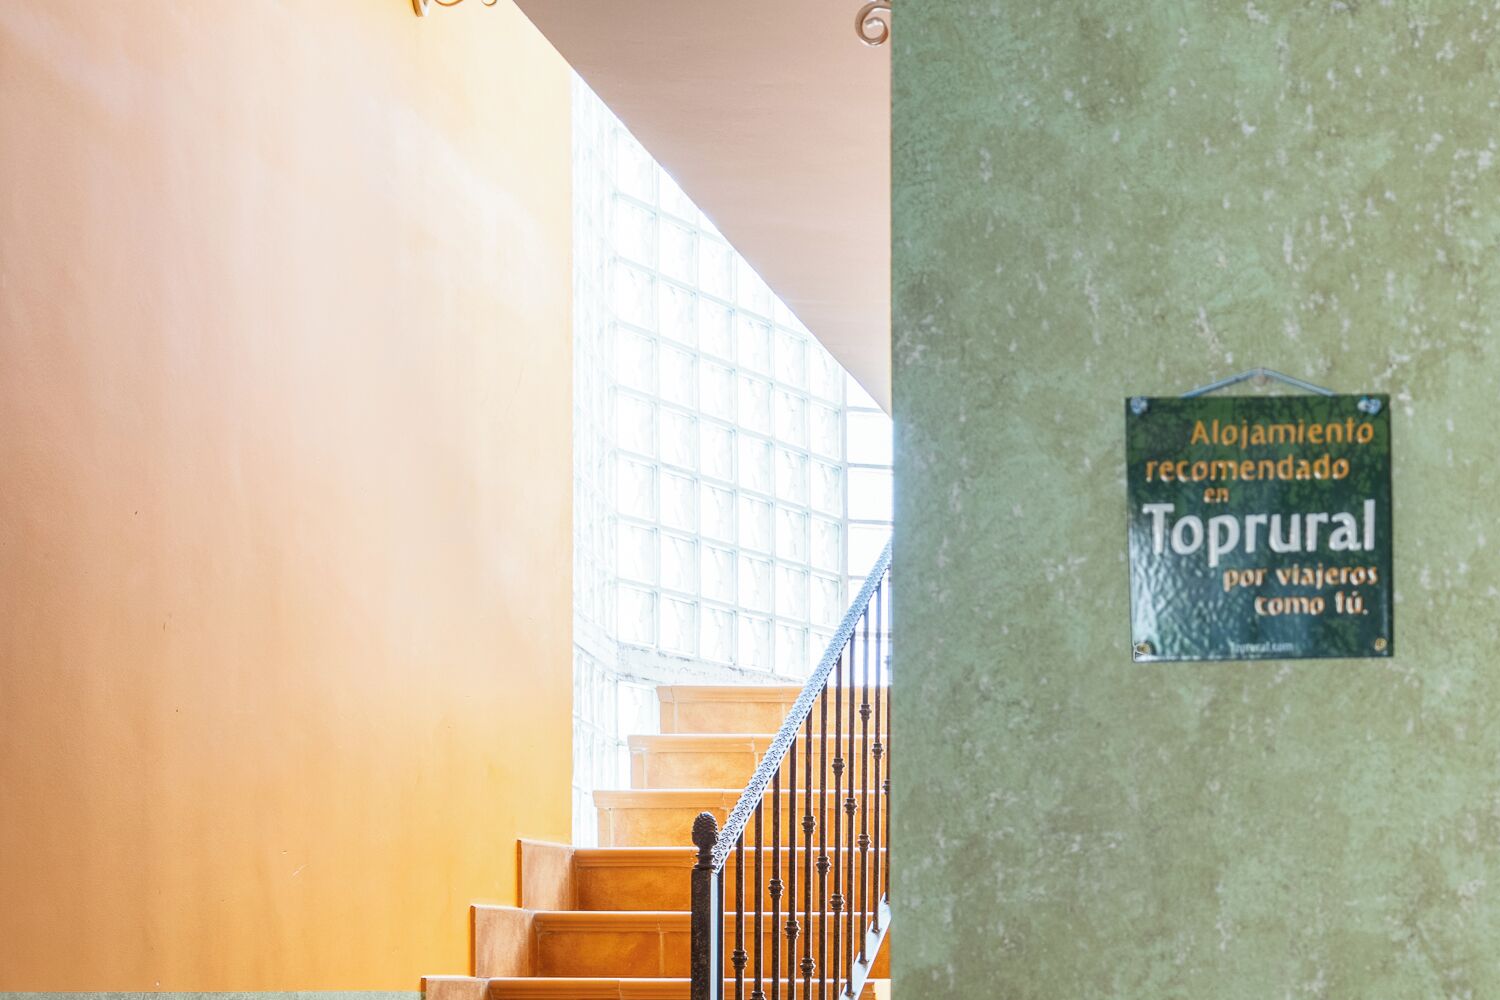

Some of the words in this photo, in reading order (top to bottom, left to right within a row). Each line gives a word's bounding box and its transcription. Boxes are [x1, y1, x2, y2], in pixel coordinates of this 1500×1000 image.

[1190, 418, 1374, 449] Alojamiento
[1145, 454, 1350, 483] recomendado
[1203, 487, 1230, 503] en
[1142, 499, 1376, 568] Toprural
[1223, 567, 1267, 592] por
[1275, 563, 1378, 589] viajeros
[1254, 595, 1325, 616] como
